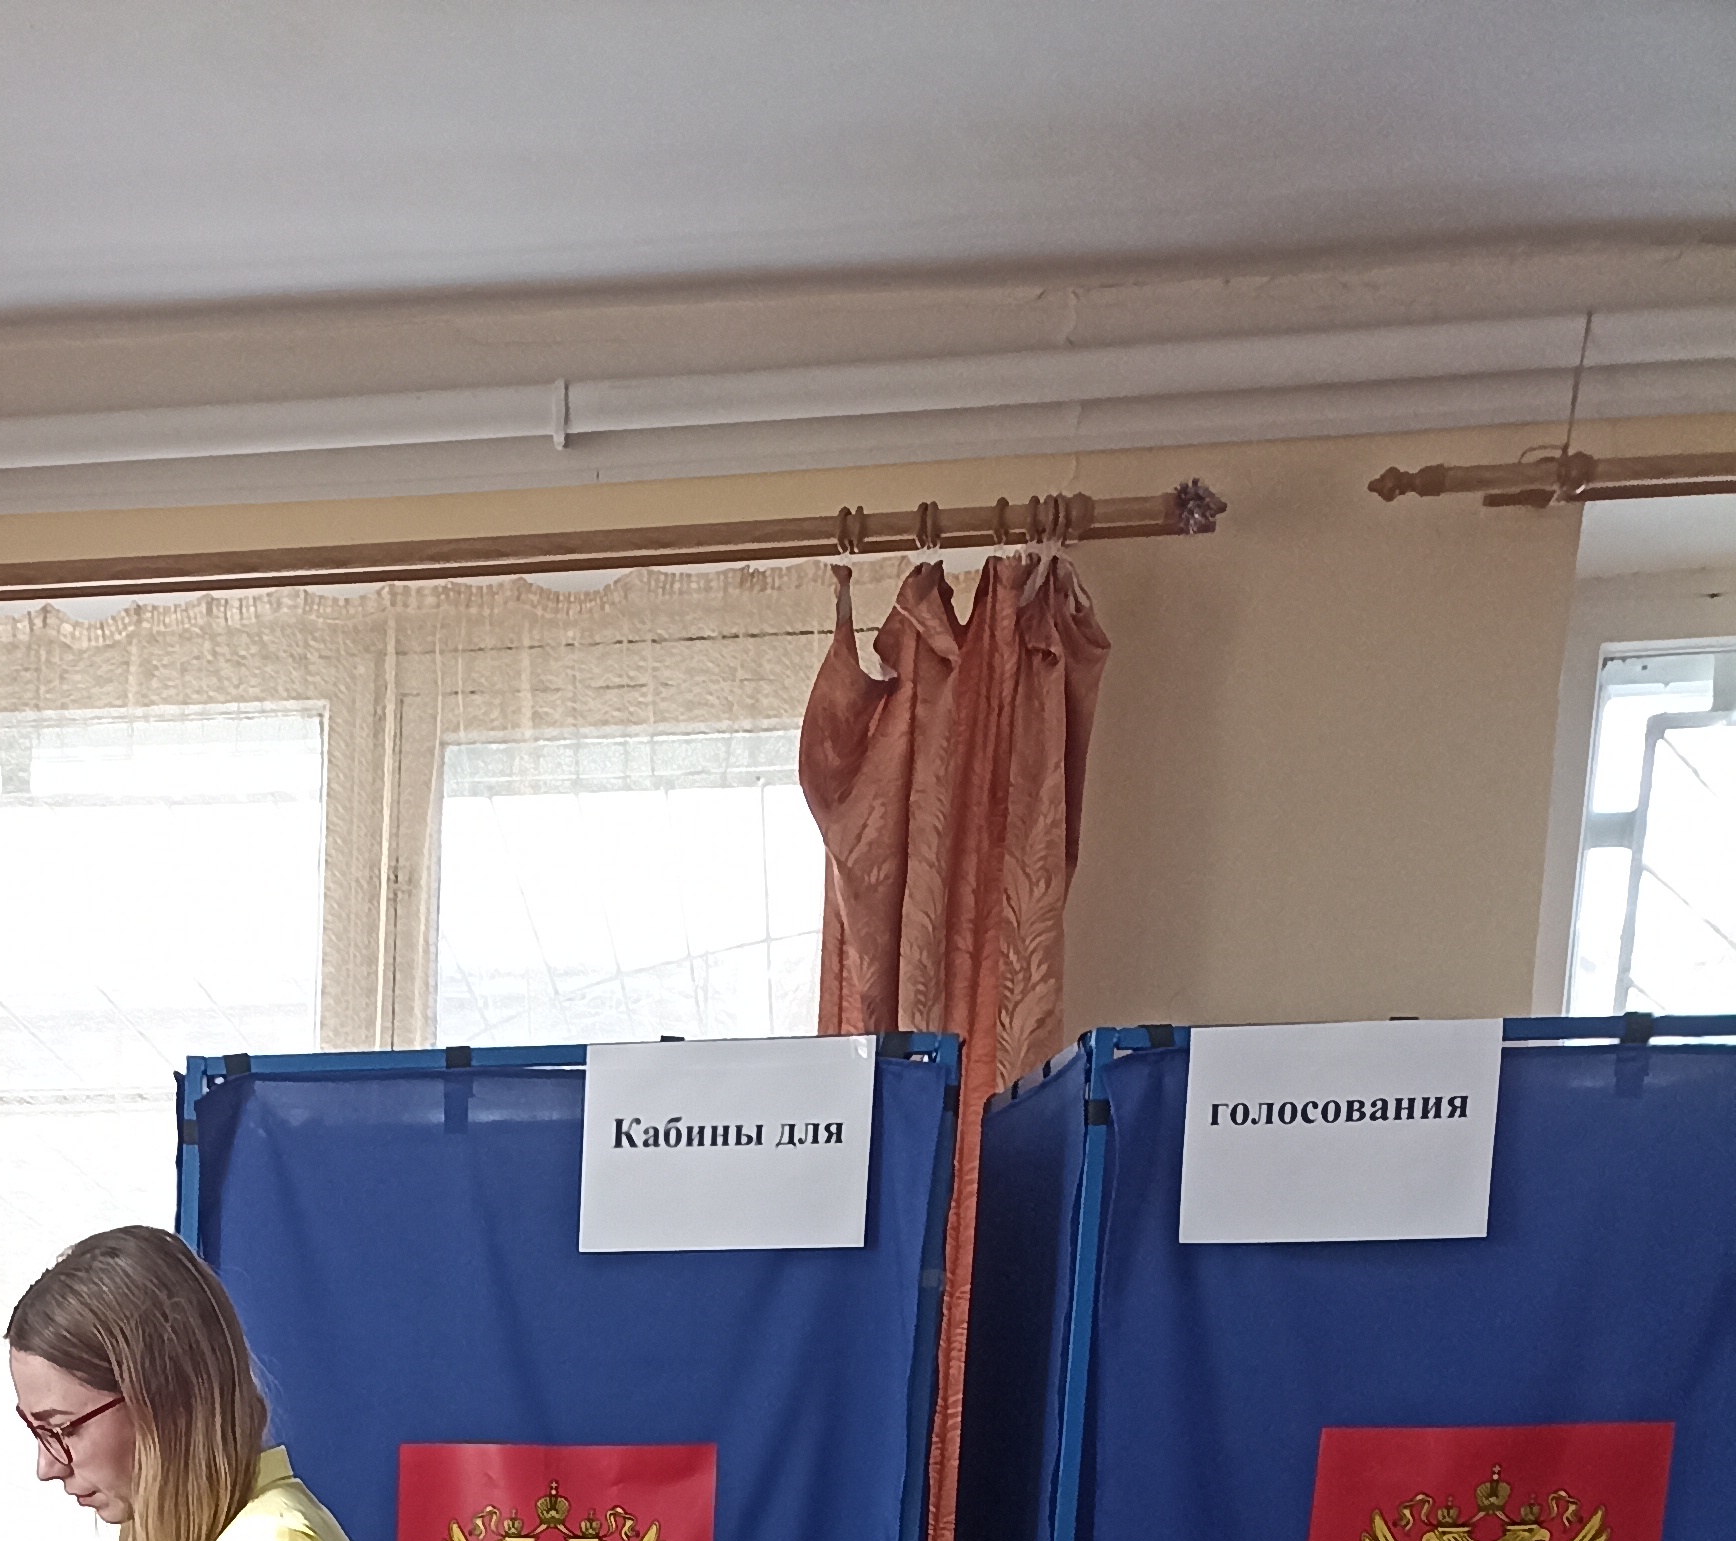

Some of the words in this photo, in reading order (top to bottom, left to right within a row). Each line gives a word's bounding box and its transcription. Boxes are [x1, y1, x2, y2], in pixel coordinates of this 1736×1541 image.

[1209, 1094, 1470, 1127] голосования
[612, 1115, 764, 1149] Кабины
[775, 1121, 845, 1149] для
